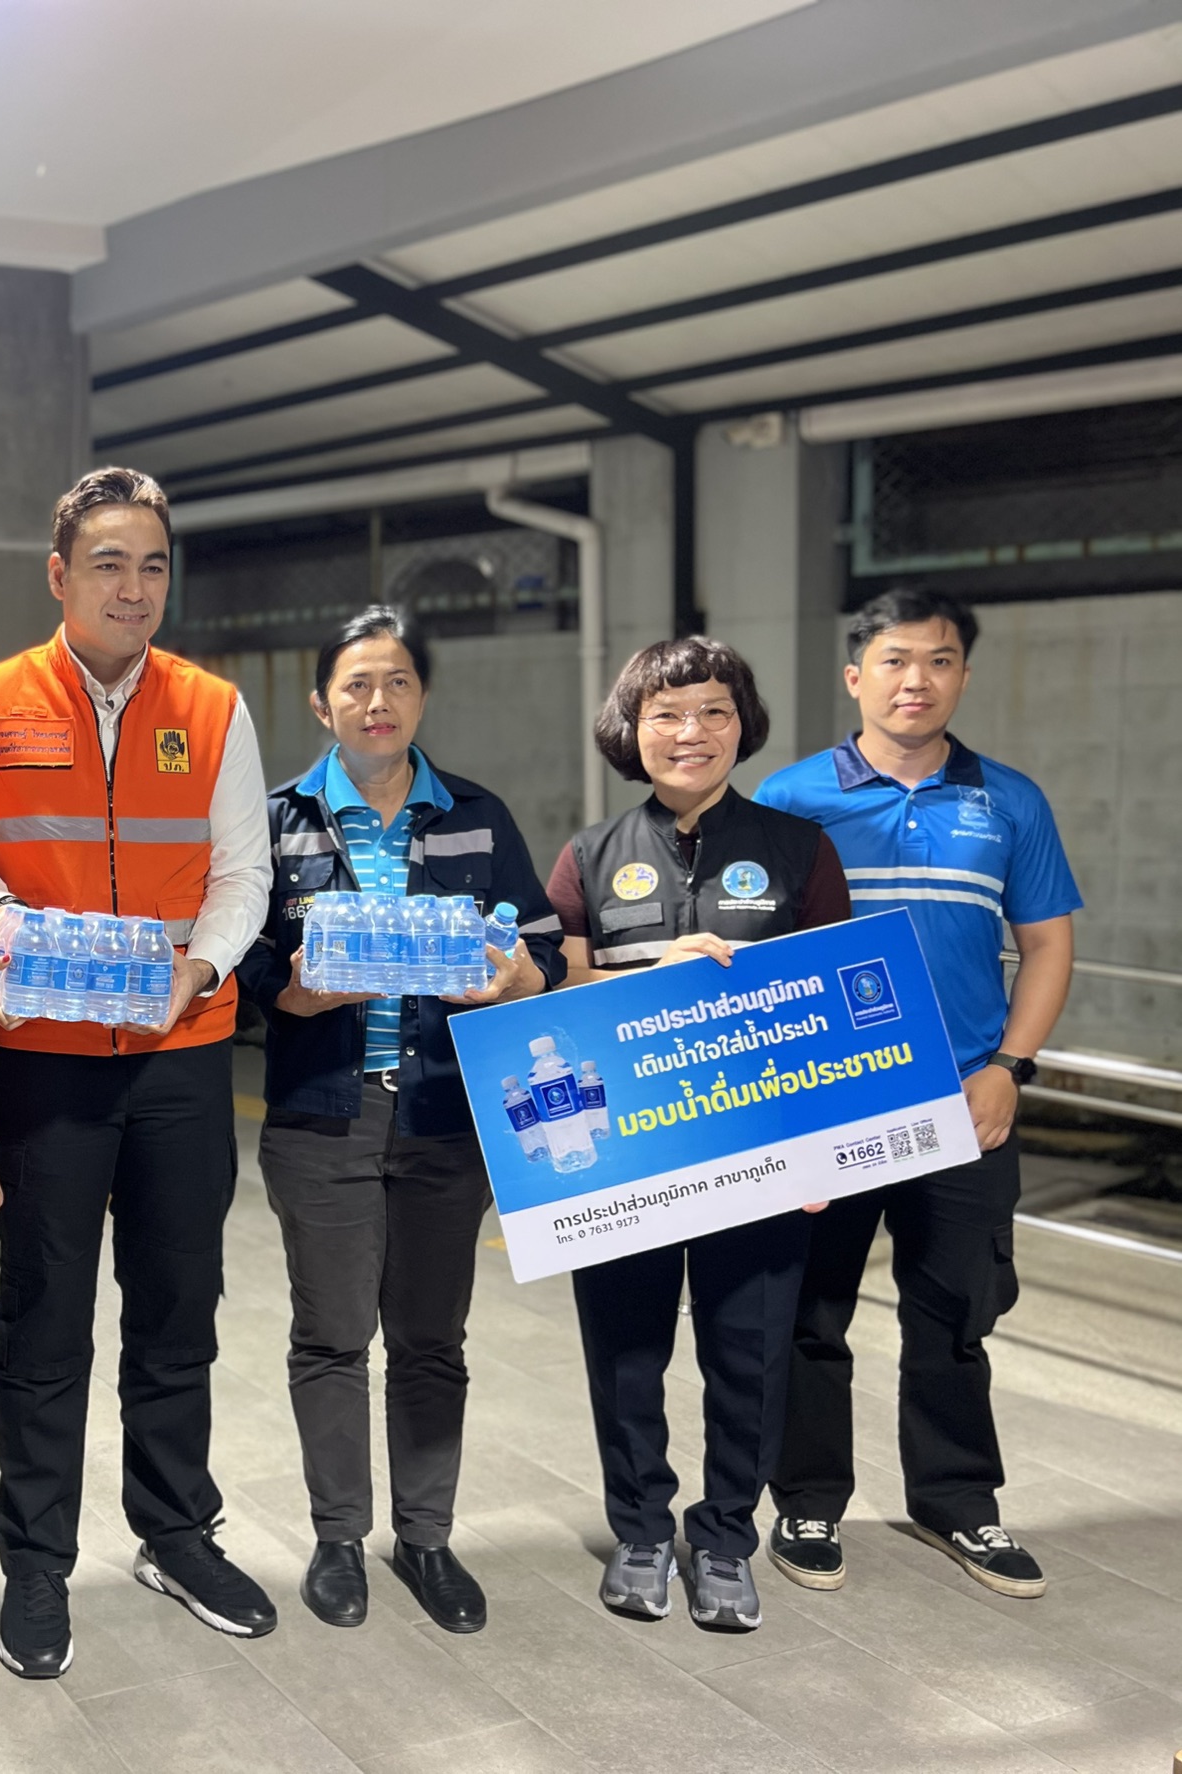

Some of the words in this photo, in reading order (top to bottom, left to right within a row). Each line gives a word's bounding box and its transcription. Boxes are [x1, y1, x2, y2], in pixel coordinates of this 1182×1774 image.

[616, 975, 824, 1042] การประปาส่วนภูมิภาค
[633, 1013, 829, 1078] เติมน้ำใจใส่น้ำประปา
[618, 1042, 913, 1137] มอบน้ำดื่มเพื่อประชาชน
[846, 1139, 864, 1148] Contact
[865, 1135, 881, 1143] Center
[848, 1142, 885, 1162] 1662
[553, 1180, 708, 1231] การประปาส่วนภูมิภาค
[714, 1157, 787, 1188] สาขาภูเก็ต
[578, 1230, 586, 1239] 0
[589, 1222, 613, 1237] 7631
[616, 1215, 640, 1229] 9173
